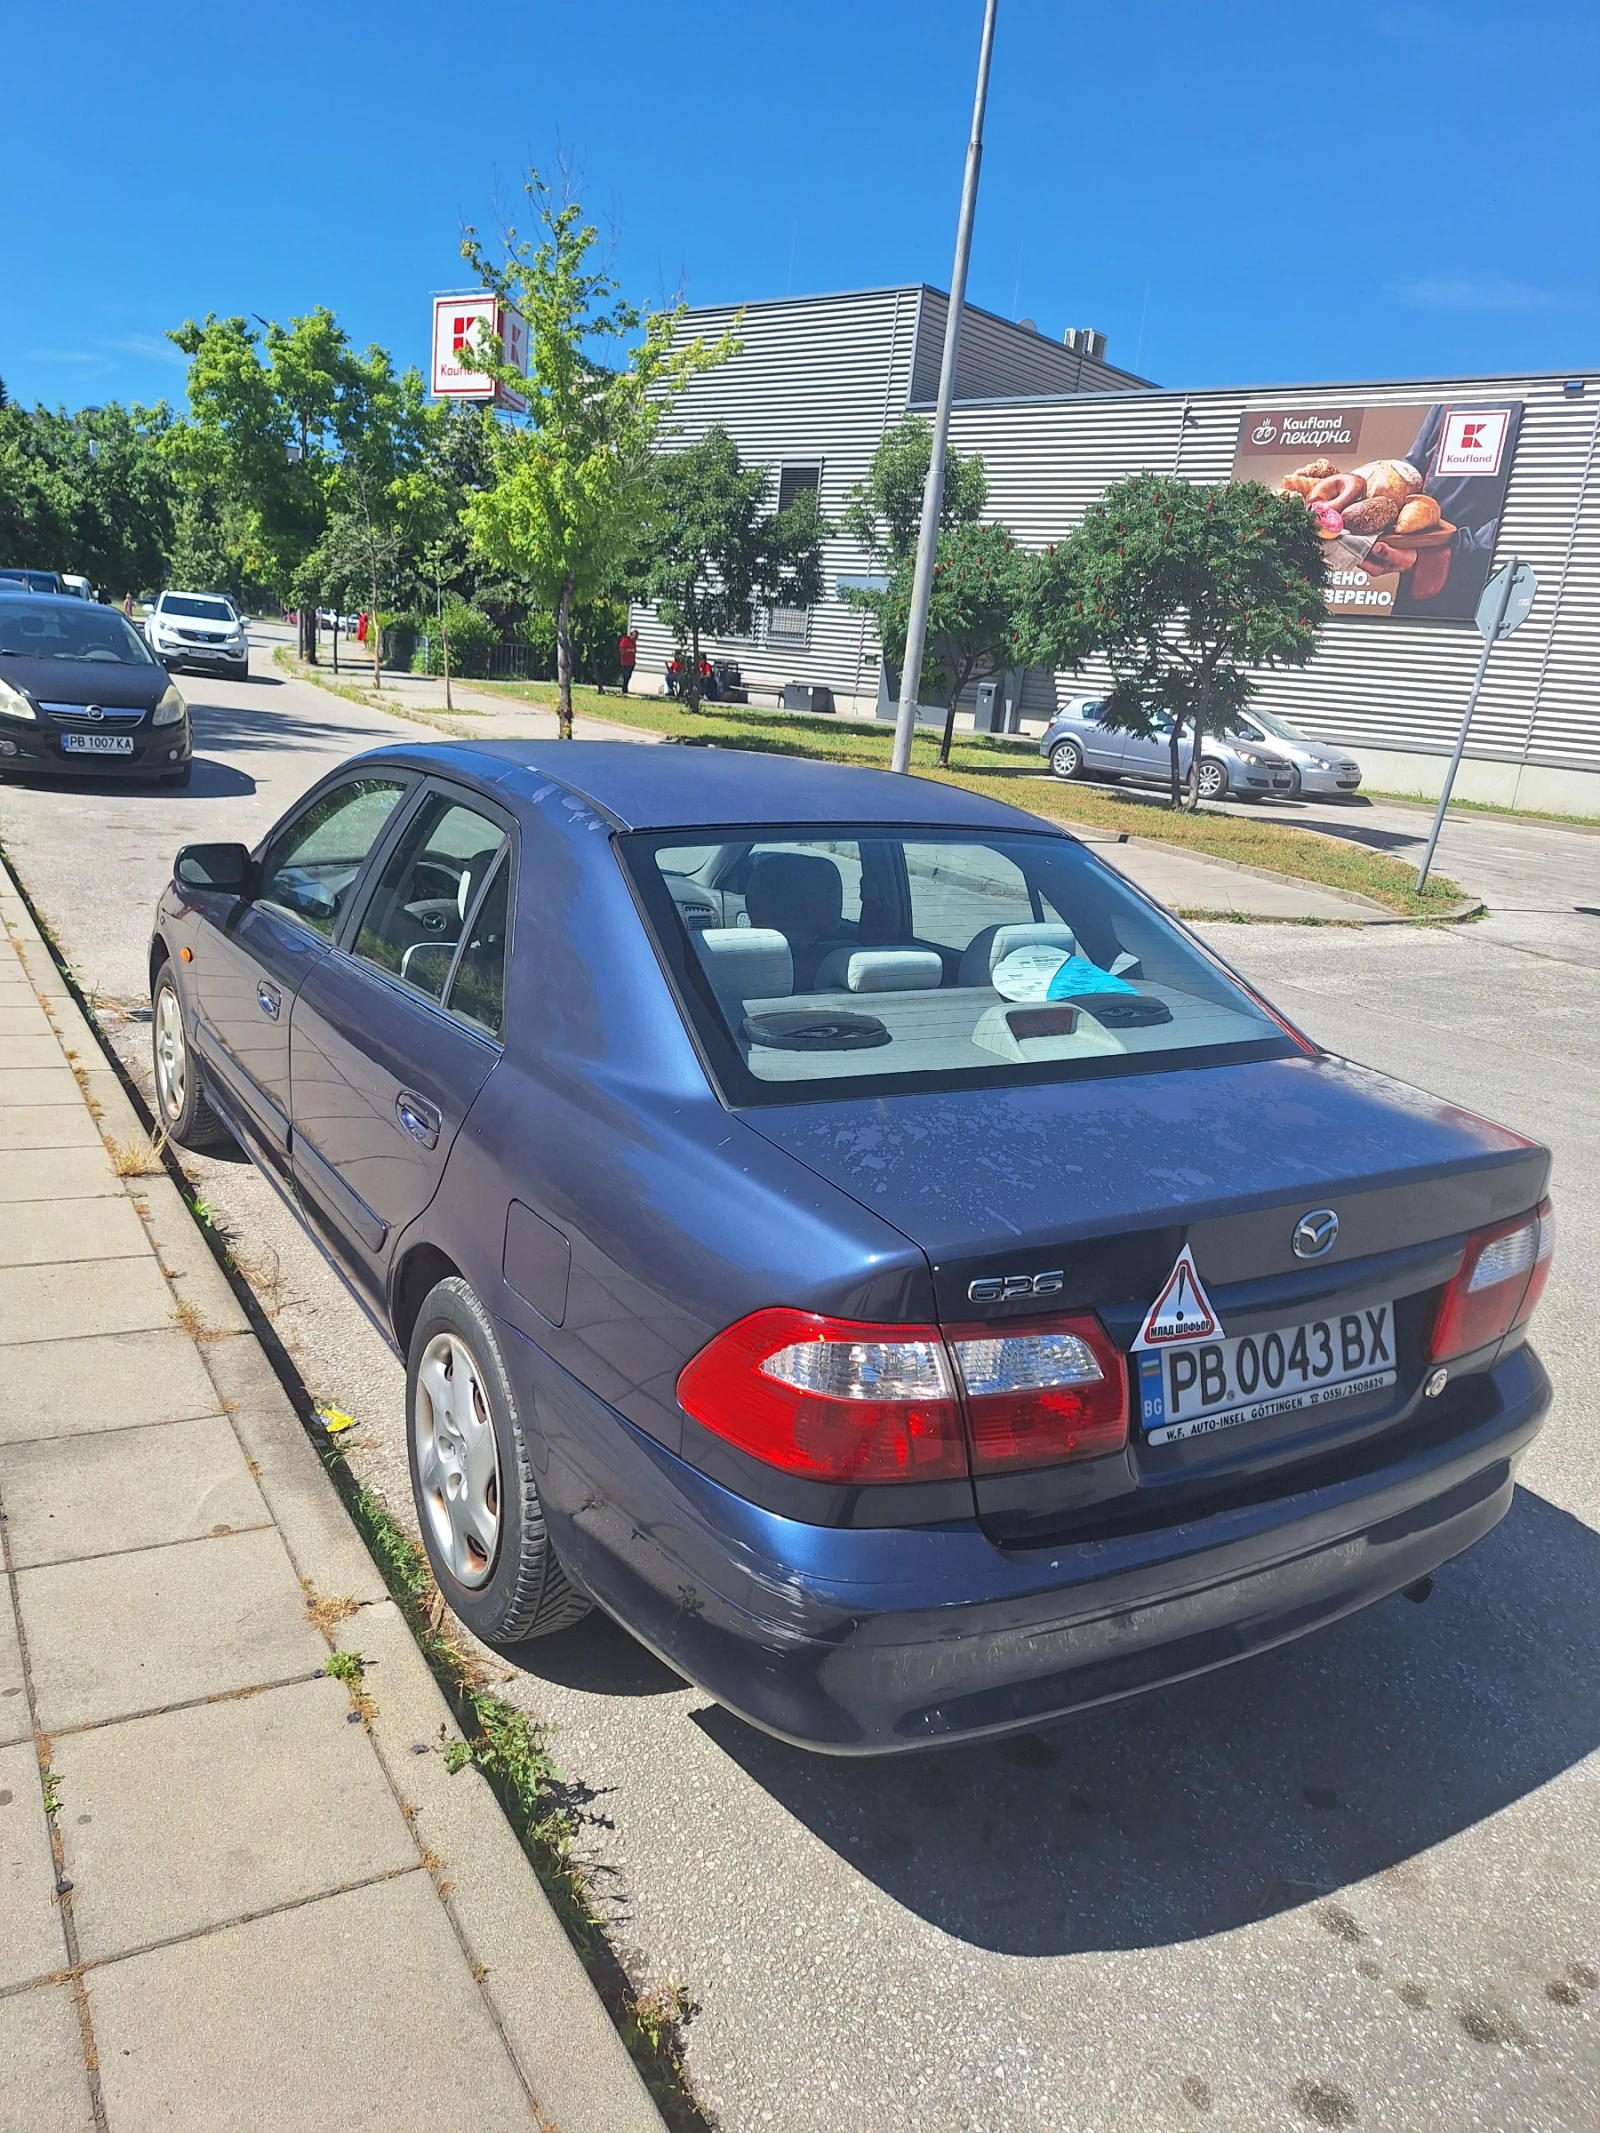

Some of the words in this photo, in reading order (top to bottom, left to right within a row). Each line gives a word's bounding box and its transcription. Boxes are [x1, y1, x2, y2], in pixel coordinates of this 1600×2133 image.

[1283, 415, 1343, 430] Kaufland
[1279, 430, 1352, 448] пекарна
[1446, 454, 1493, 463] Kaufland
[70, 736, 85, 747] PB
[89, 737, 115, 748] 1007
[116, 738, 132, 749] KA
[968, 1270, 1064, 1303] 626
[1150, 1325, 1174, 1338] МЛАД
[1175, 1320, 1210, 1334] ШОФЬОР
[1169, 1345, 1227, 1414] PB
[1236, 1321, 1333, 1396] 0043
[1340, 1307, 1390, 1372] BX
[1144, 1398, 1163, 1418] BG
[1166, 1427, 1185, 1441] W.F.
[1191, 1412, 1246, 1435] AUTO-INSEL
[1251, 1397, 1303, 1419] GÖTTINGEN
